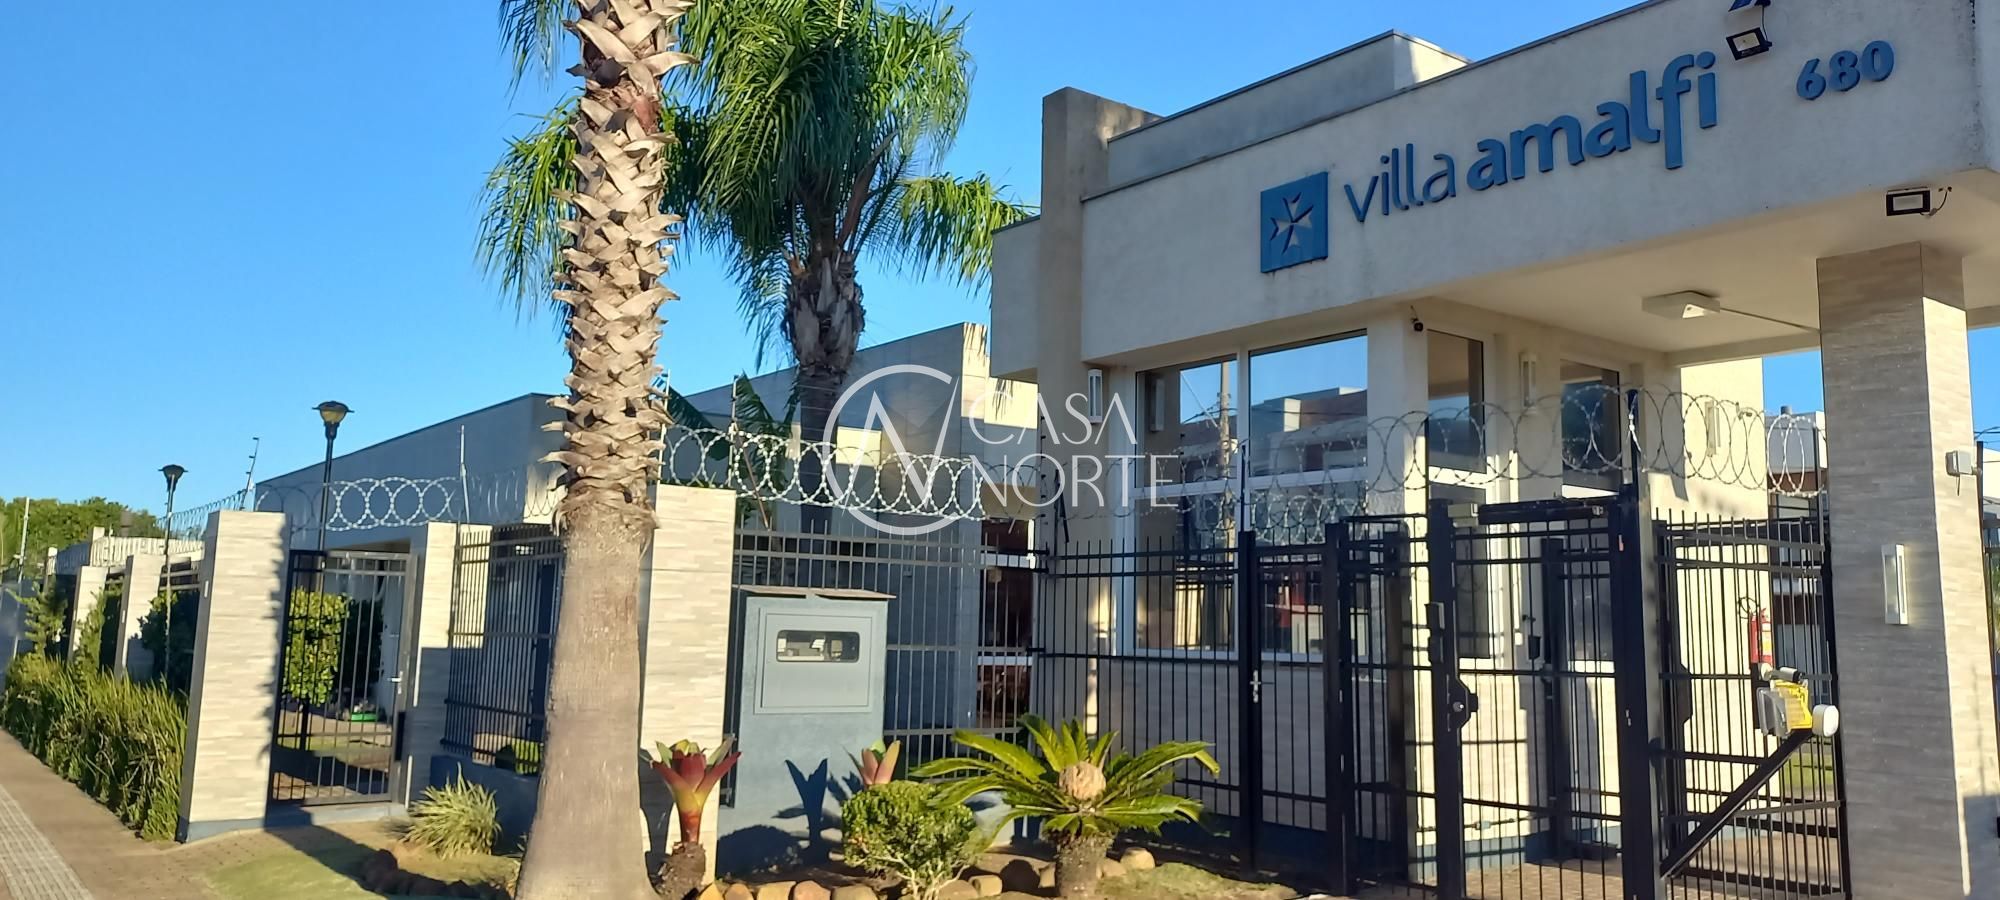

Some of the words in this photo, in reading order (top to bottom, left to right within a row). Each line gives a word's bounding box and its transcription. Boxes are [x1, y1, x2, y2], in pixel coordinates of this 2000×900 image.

[1797, 40, 1894, 100] 680
[1344, 142, 1457, 222] villa
[1466, 51, 1718, 191] amalfi
